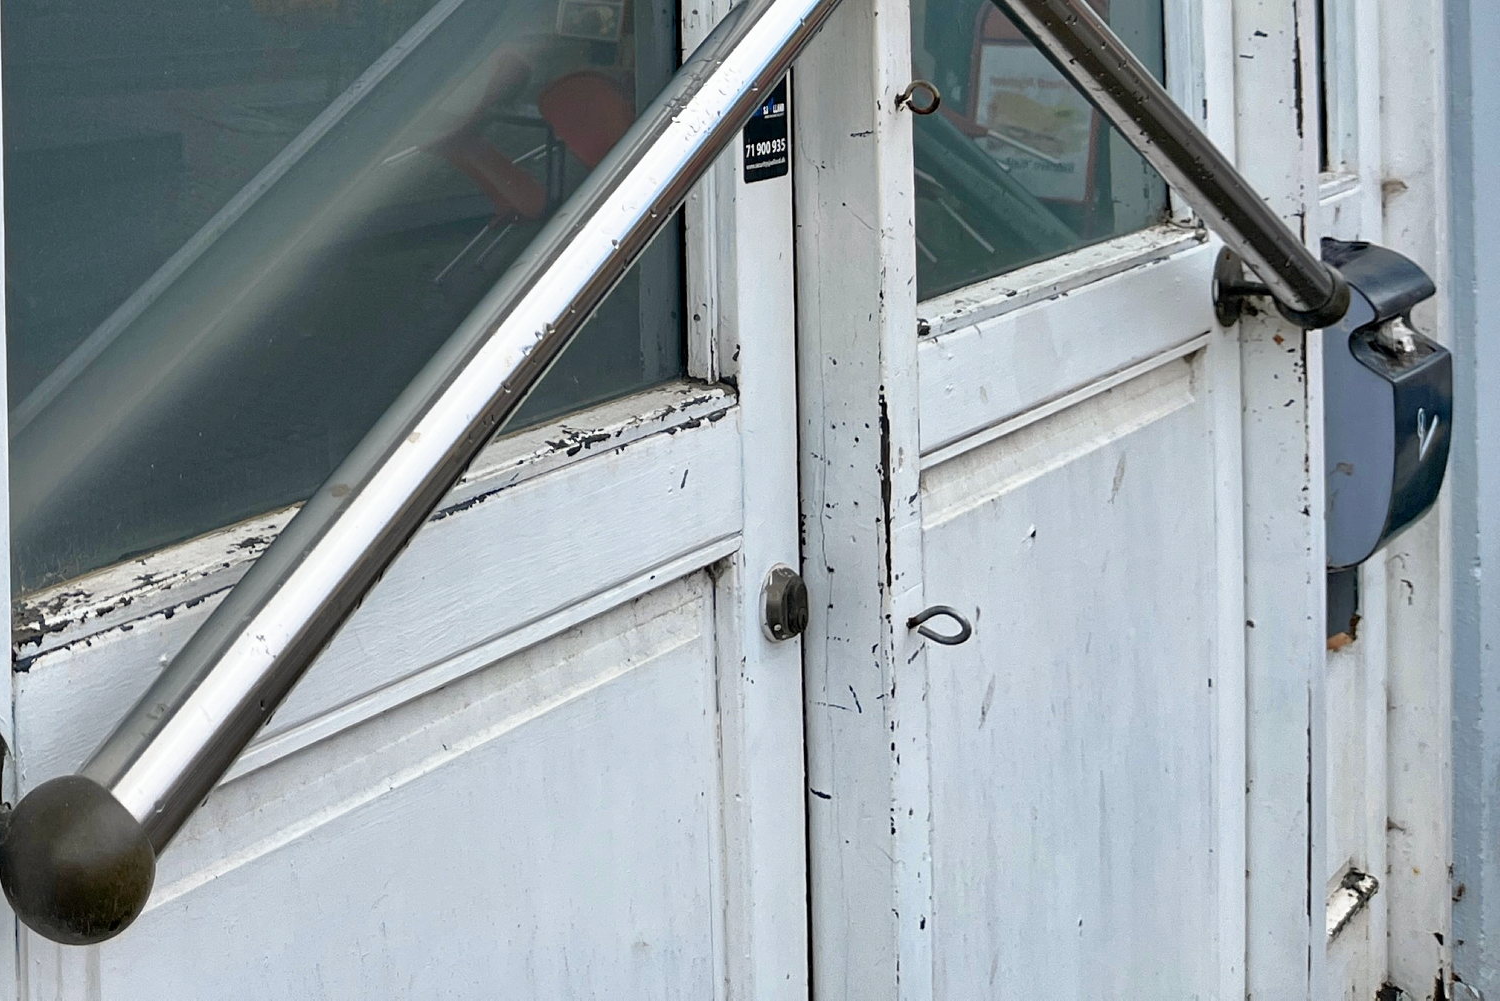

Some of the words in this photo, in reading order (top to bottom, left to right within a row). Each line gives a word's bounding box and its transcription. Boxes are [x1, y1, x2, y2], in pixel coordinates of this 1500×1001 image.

[745, 143, 755, 158] 71
[756, 140, 771, 156] 900
[772, 138, 786, 154] 935
